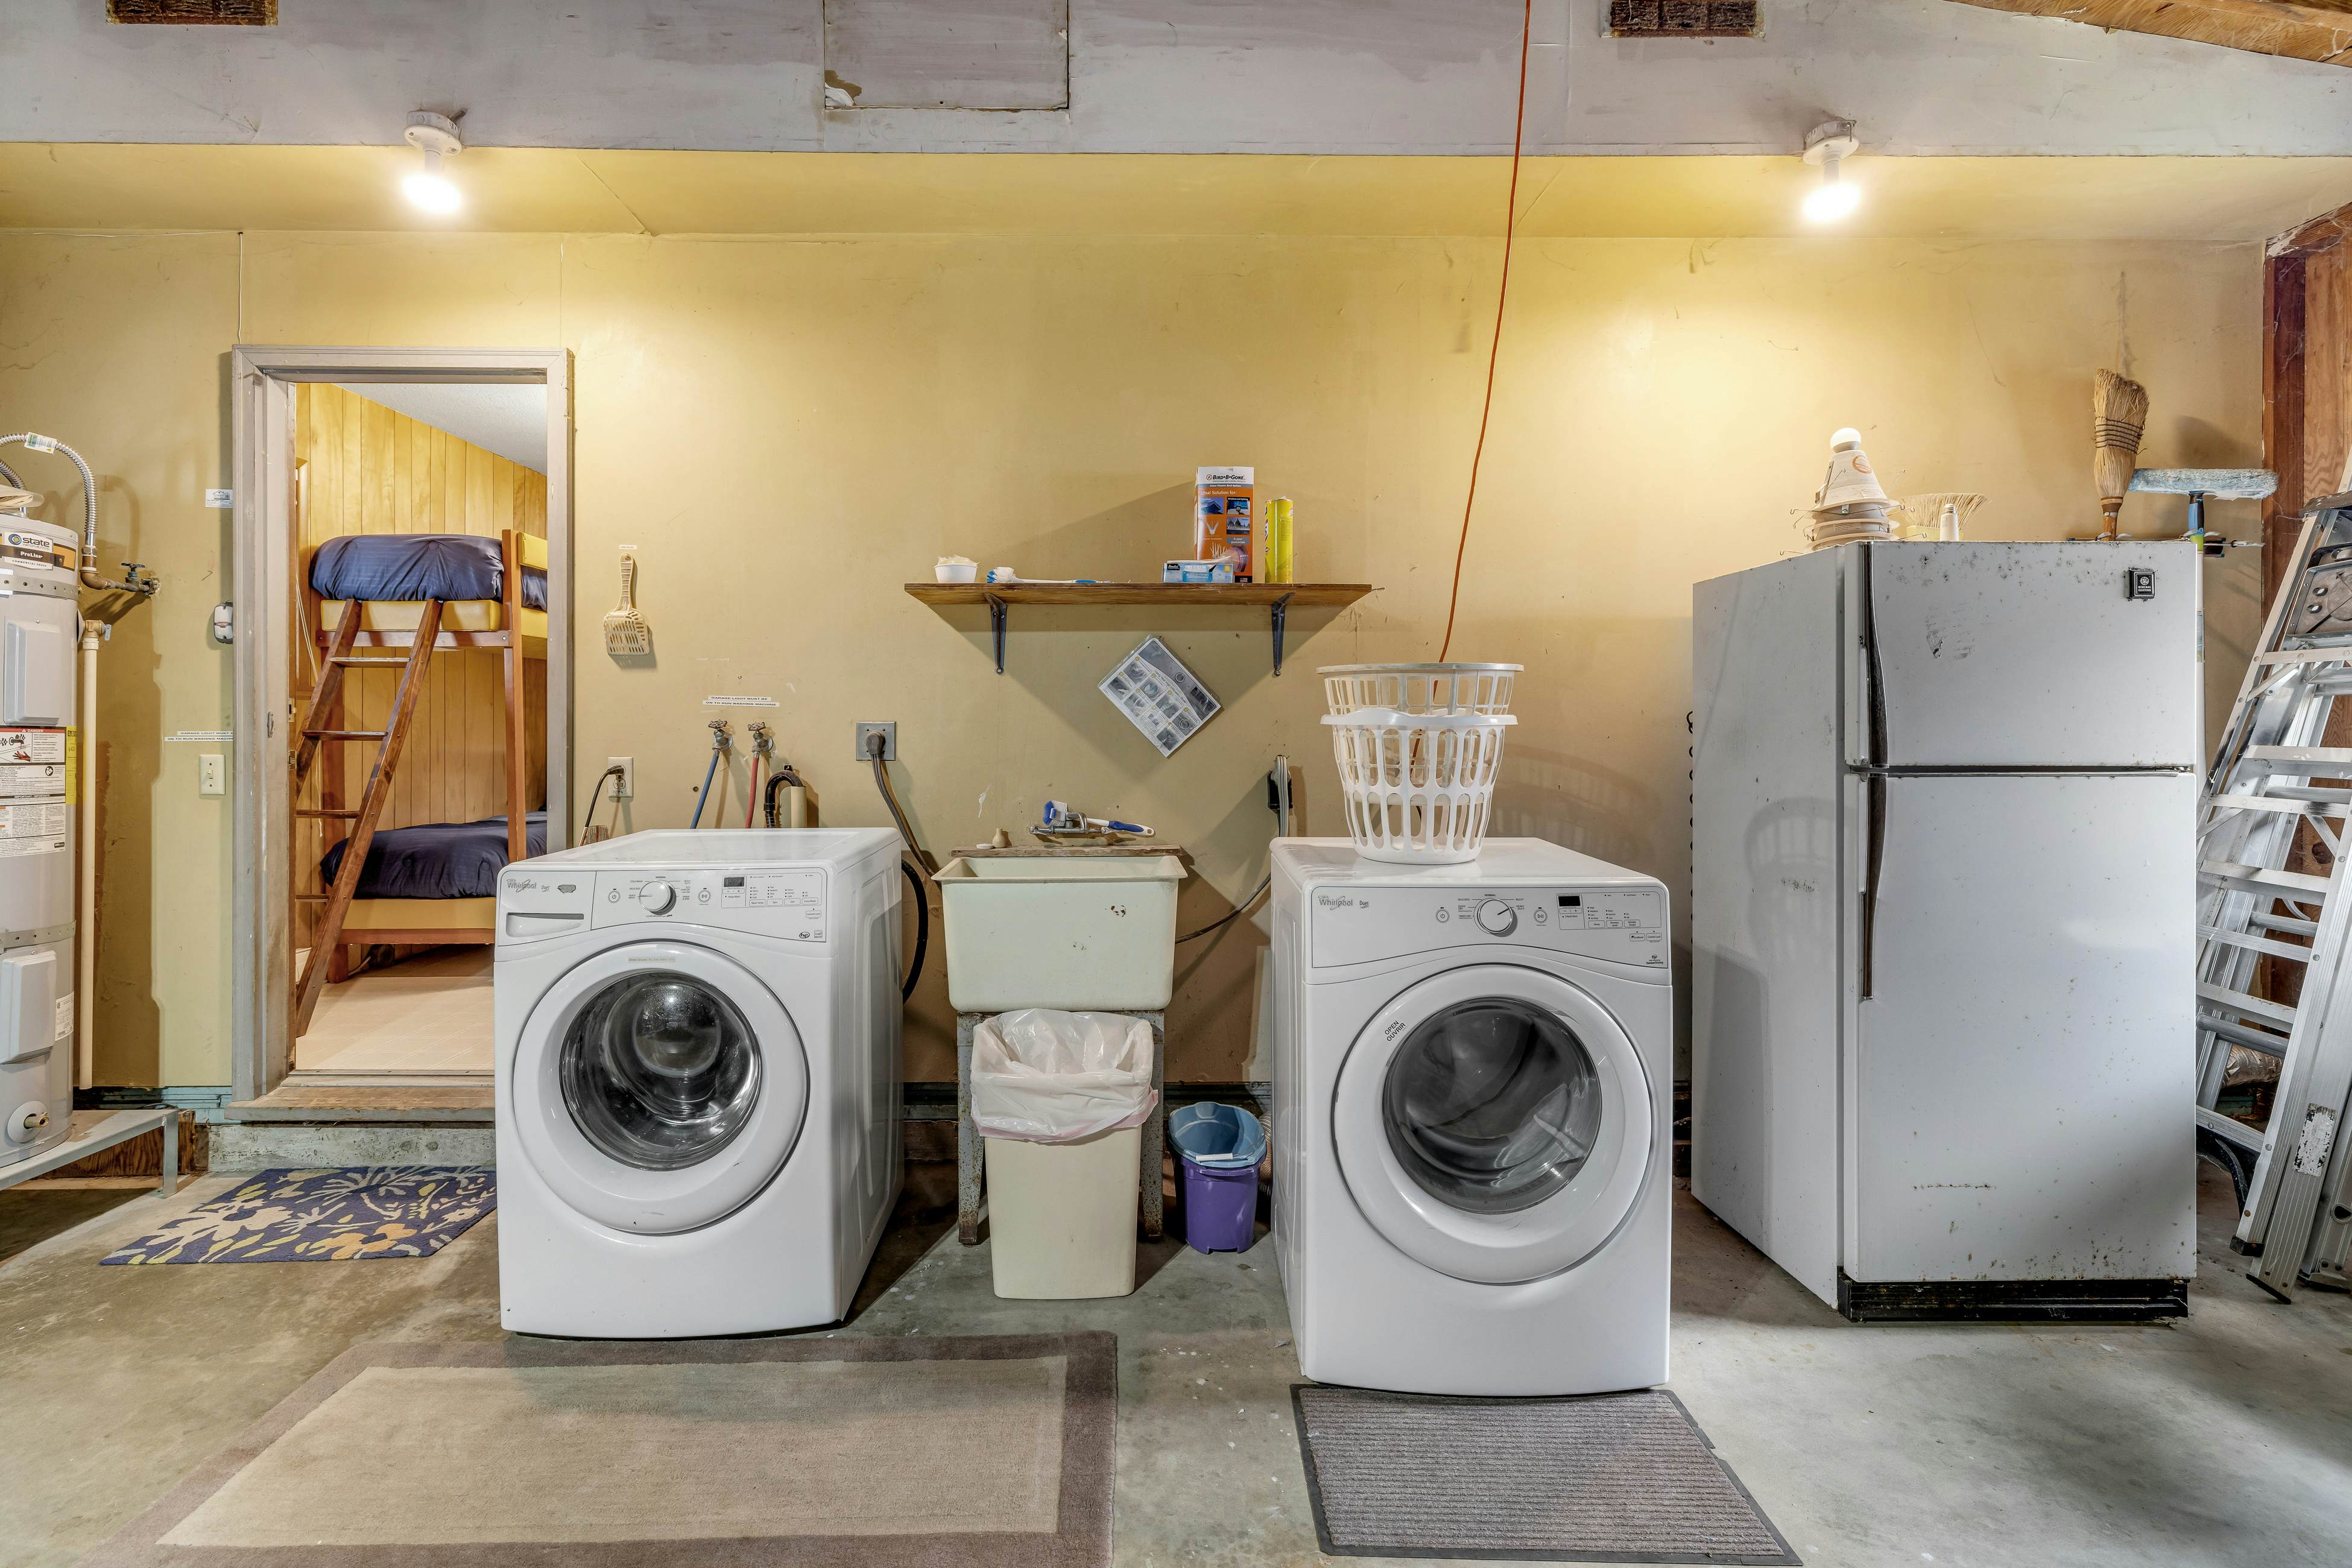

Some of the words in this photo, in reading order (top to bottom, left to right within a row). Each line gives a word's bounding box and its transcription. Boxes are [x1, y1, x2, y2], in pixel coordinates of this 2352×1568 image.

[22, 537, 50, 548] state
[507, 881, 537, 890] Whirlpool
[1319, 899, 1353, 908] Whirlpool
[1385, 1020, 1399, 1035] OPEN
[1386, 1022, 1406, 1042] OUVRIR
